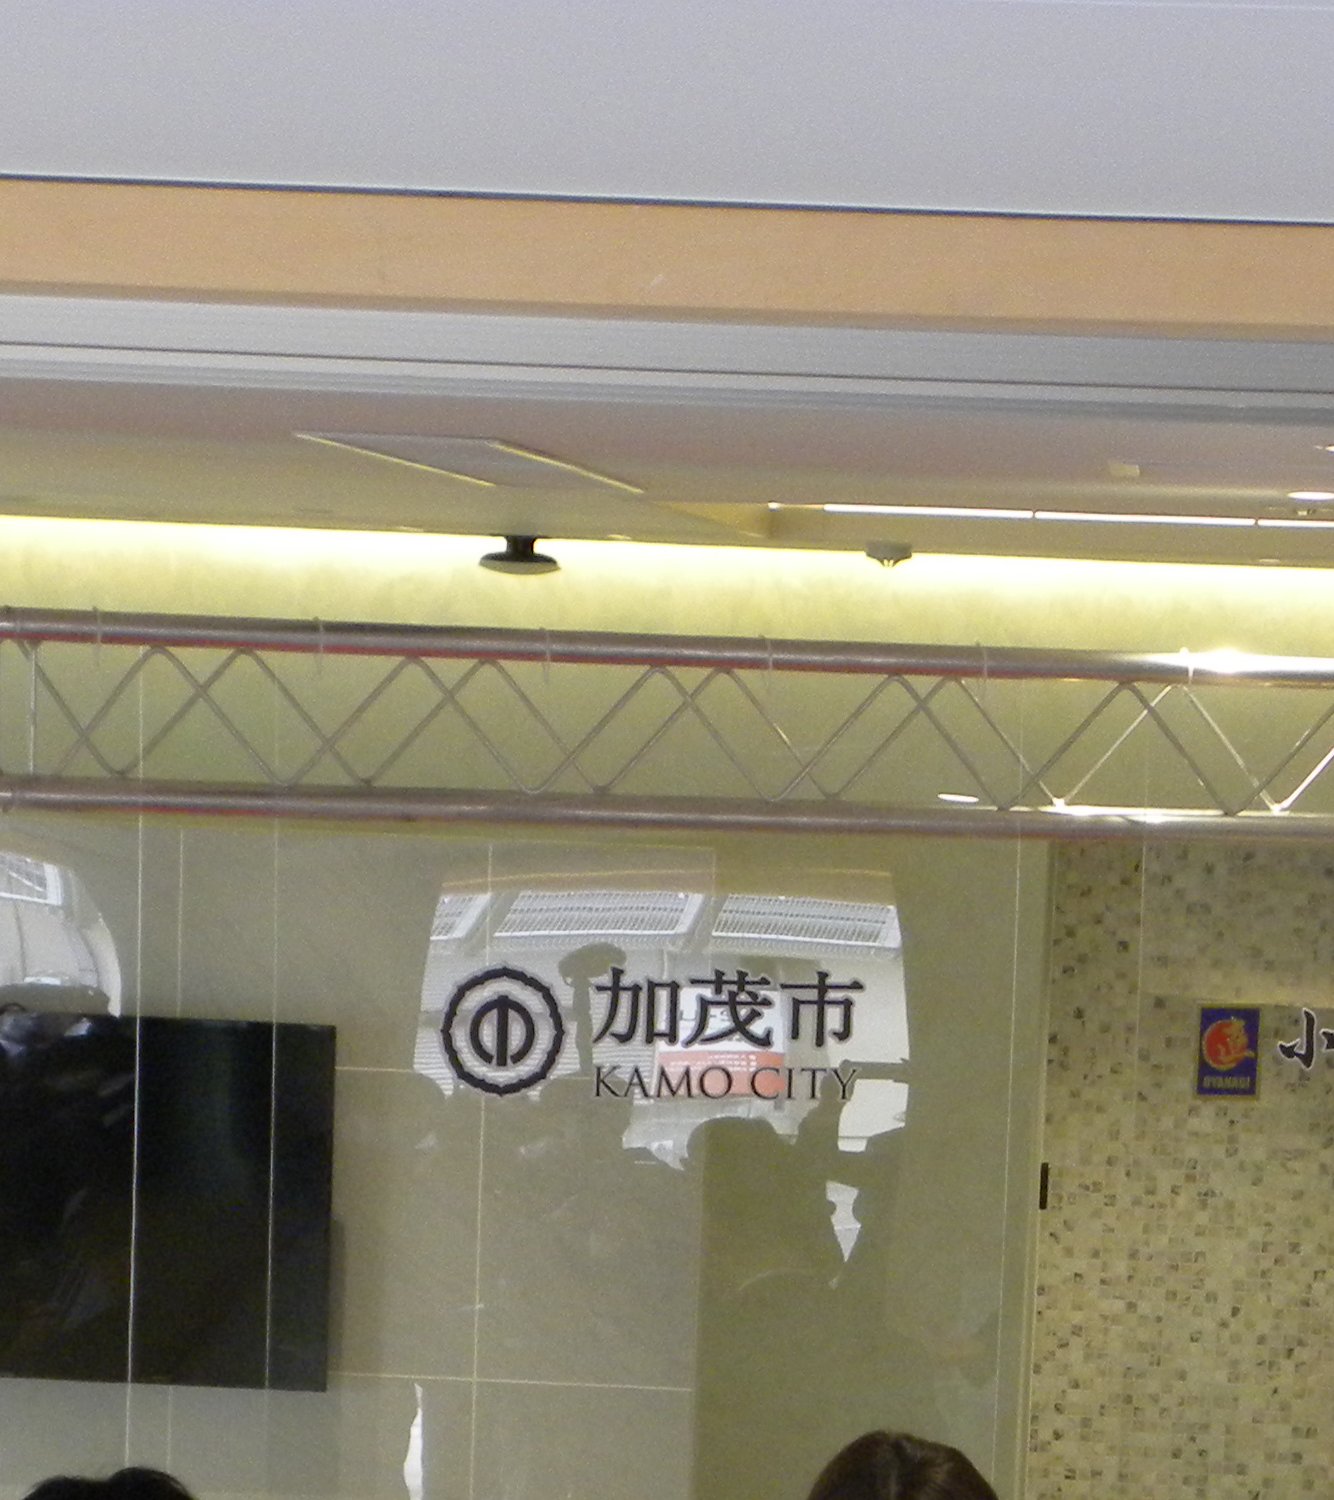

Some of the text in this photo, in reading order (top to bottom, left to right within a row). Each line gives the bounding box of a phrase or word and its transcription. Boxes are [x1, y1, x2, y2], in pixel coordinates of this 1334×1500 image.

[592, 966, 866, 1048] 加茂市
[593, 1065, 859, 1100] KAMO CITY
